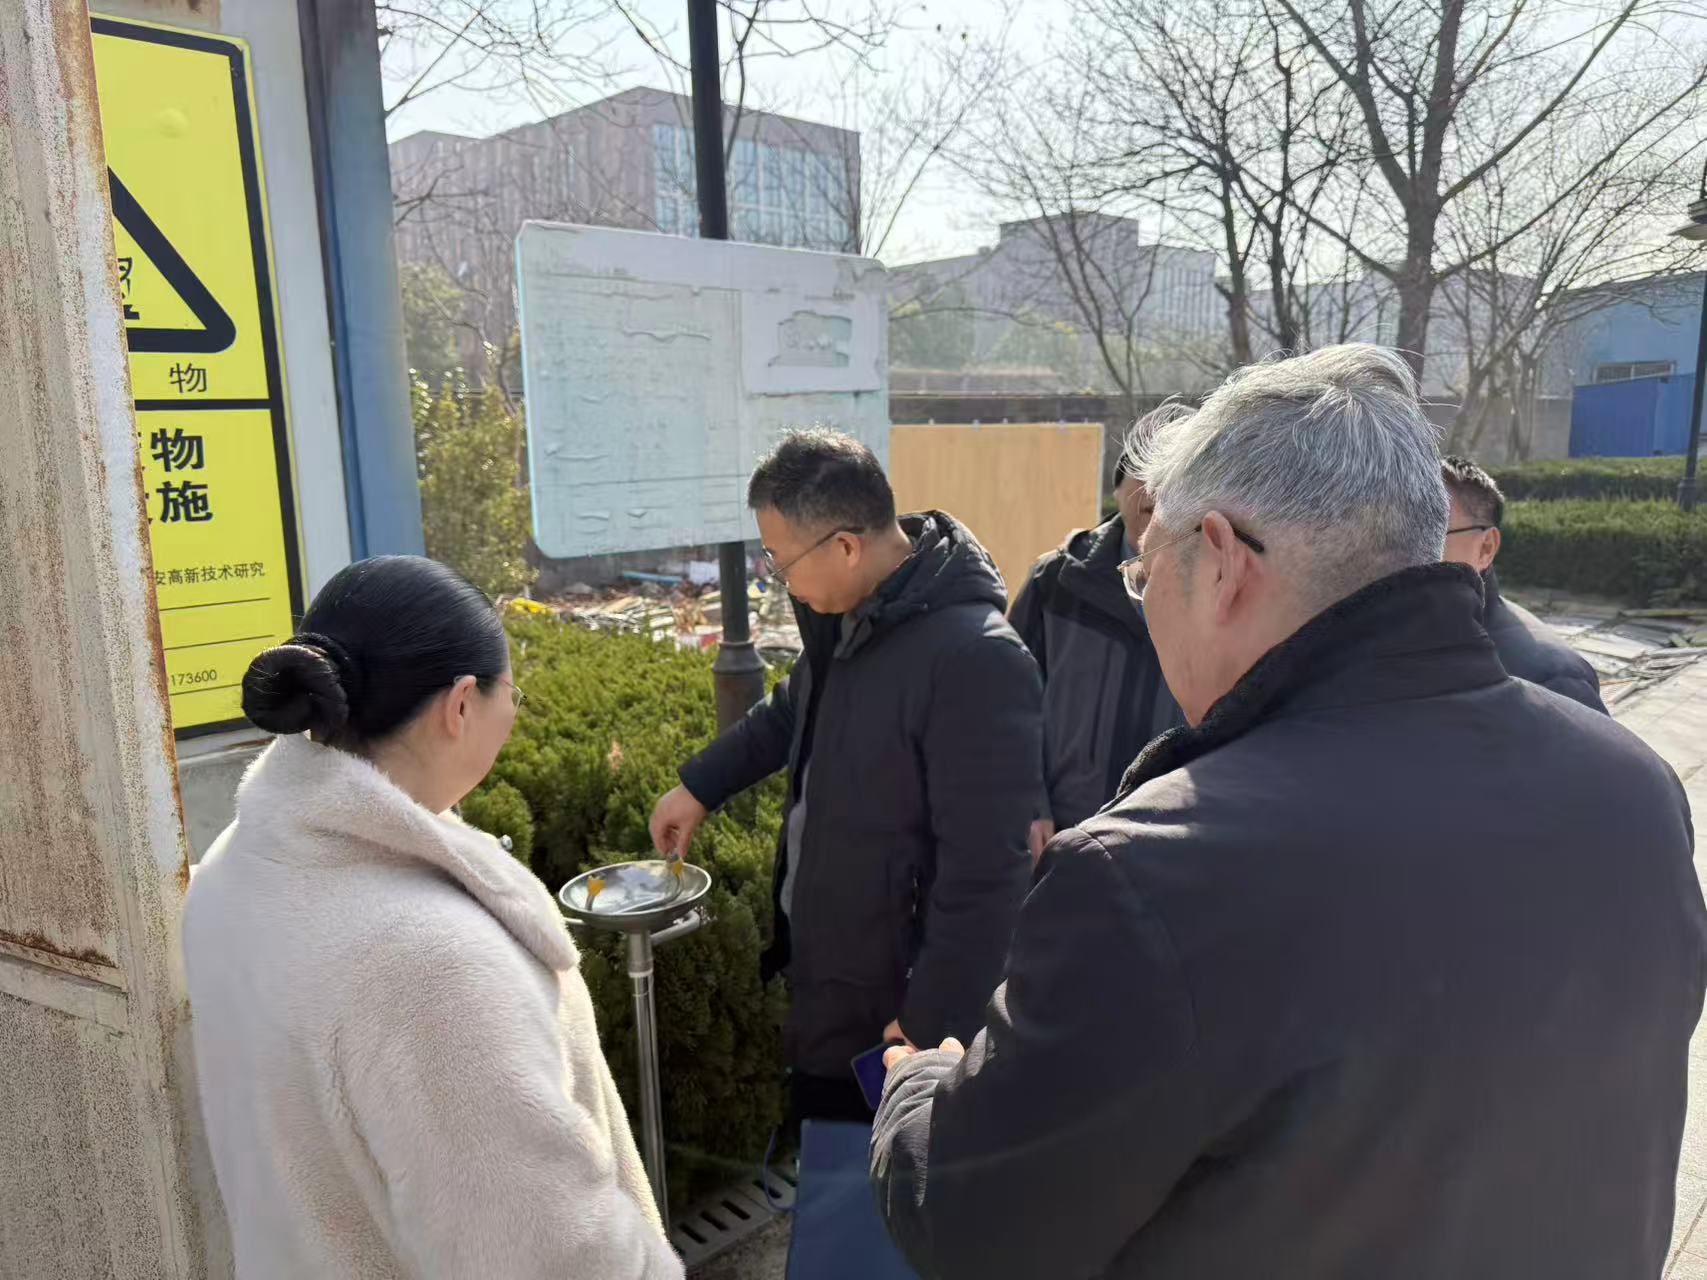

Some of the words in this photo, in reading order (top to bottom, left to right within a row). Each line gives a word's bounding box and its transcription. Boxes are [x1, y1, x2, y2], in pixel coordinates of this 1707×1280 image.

[169, 363, 207, 393] 物
[138, 428, 205, 472] 物
[145, 481, 213, 523] 施
[170, 669, 217, 687] 173600
